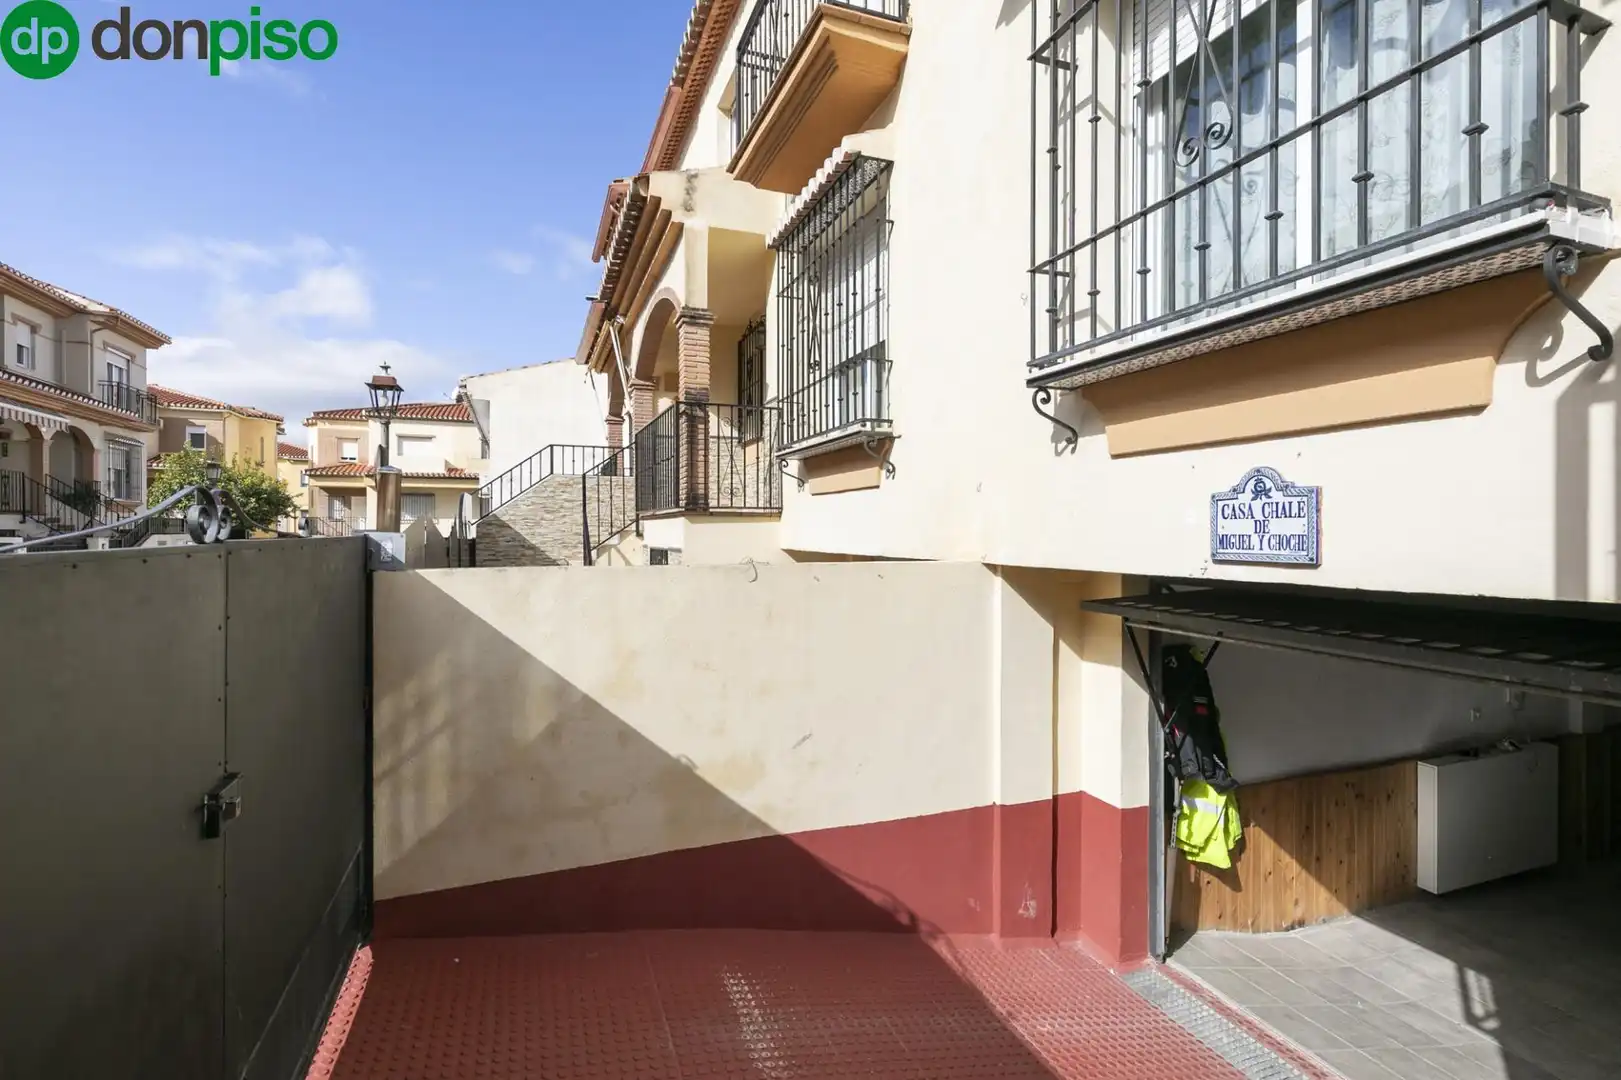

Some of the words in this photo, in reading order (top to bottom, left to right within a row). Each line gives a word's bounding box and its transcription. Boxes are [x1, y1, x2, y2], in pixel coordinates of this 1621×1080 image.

[1221, 502, 1256, 520] CASA
[1254, 519, 1270, 534] DE
[1217, 533, 1255, 550] MIGUEL
[1258, 534, 1265, 551] Y
[1268, 533, 1307, 552] CHOCHE
